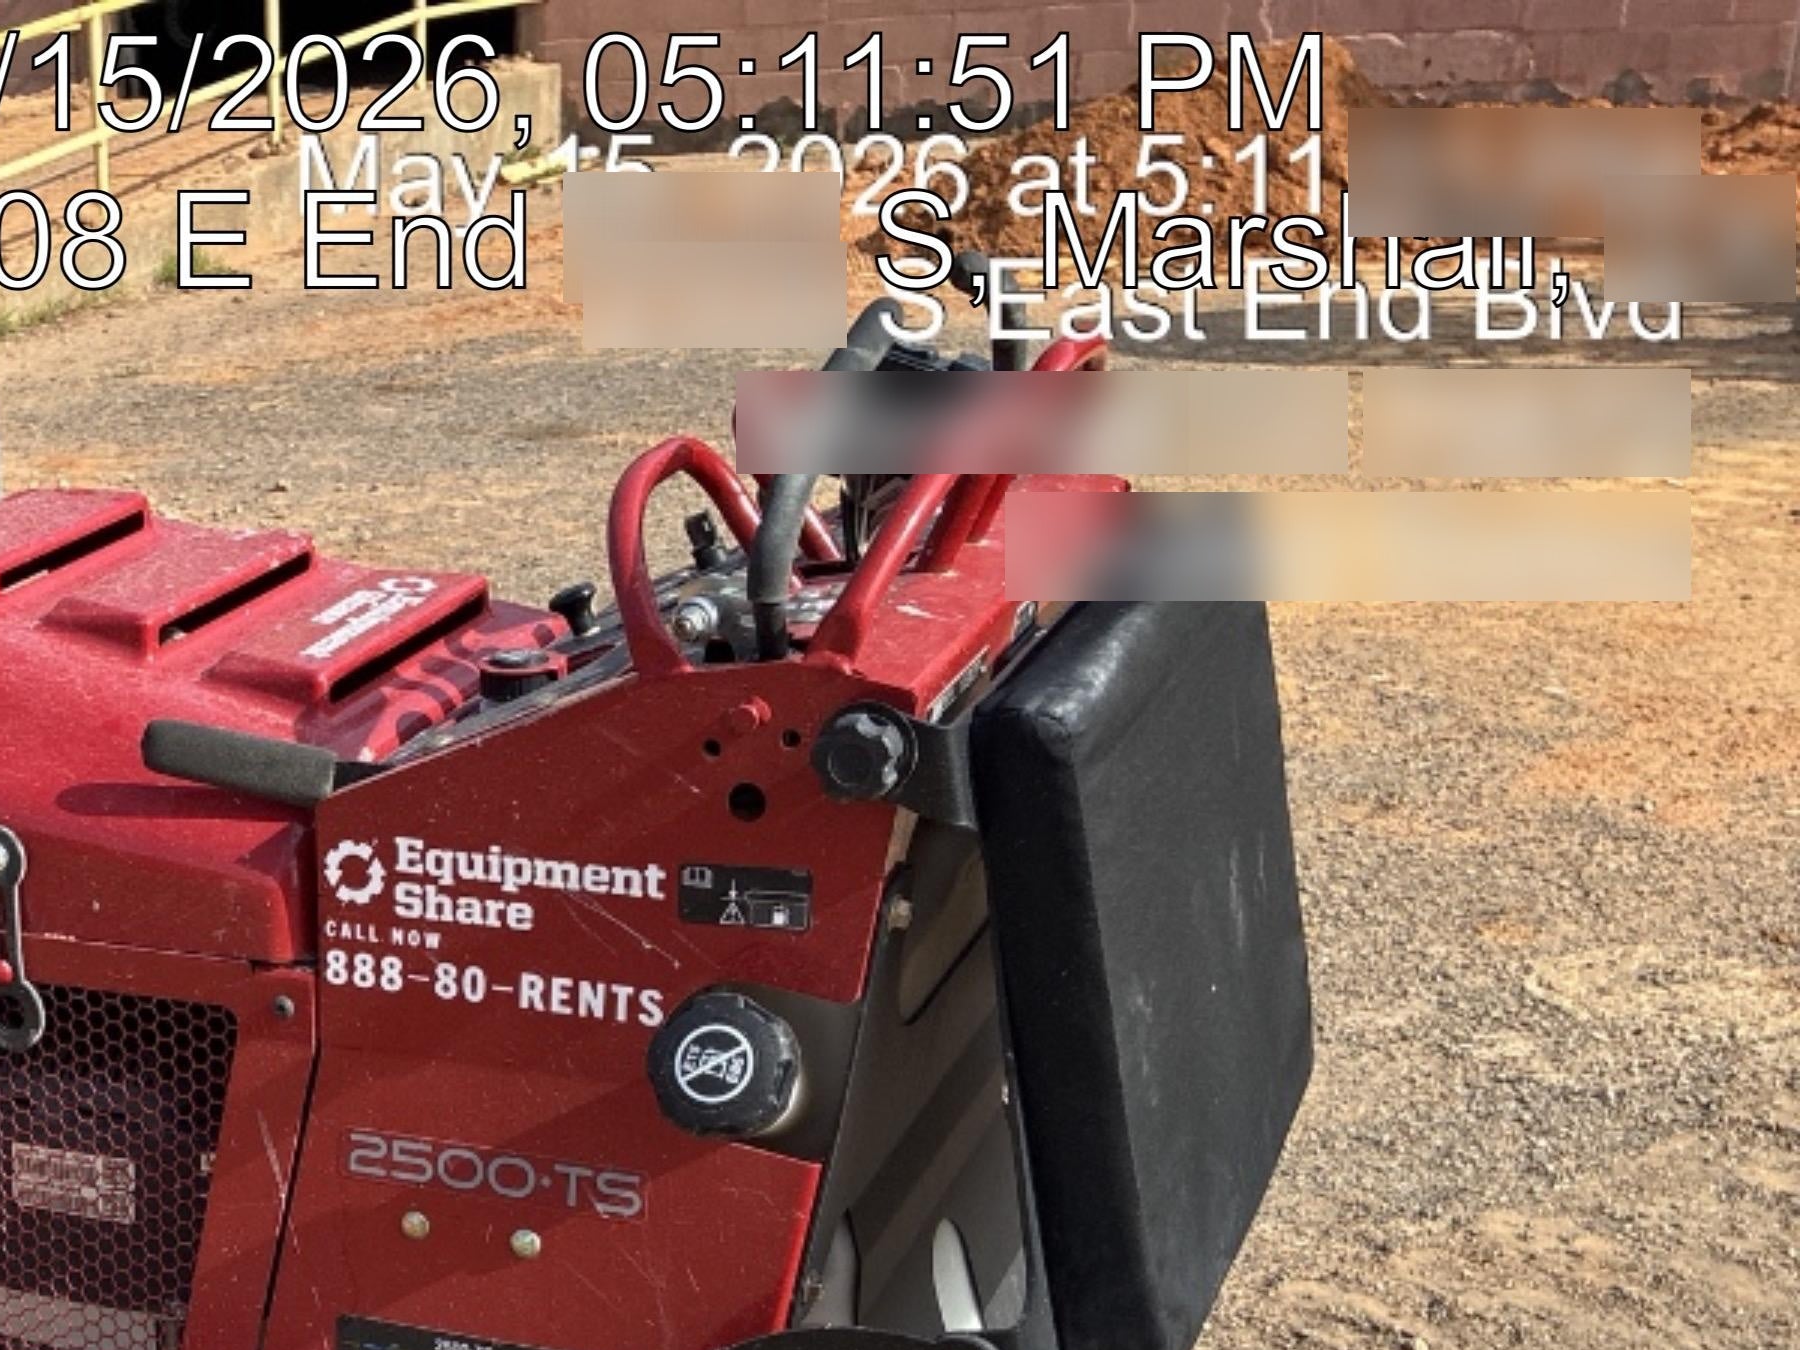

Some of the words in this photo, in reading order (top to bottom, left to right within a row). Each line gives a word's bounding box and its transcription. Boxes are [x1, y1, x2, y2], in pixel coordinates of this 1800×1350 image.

[394, 836, 667, 900] Equipment
[394, 882, 534, 930] Share
[325, 921, 380, 943] CALL
[393, 929, 442, 950] NOW
[325, 950, 665, 1027] 888-80-RENTS
